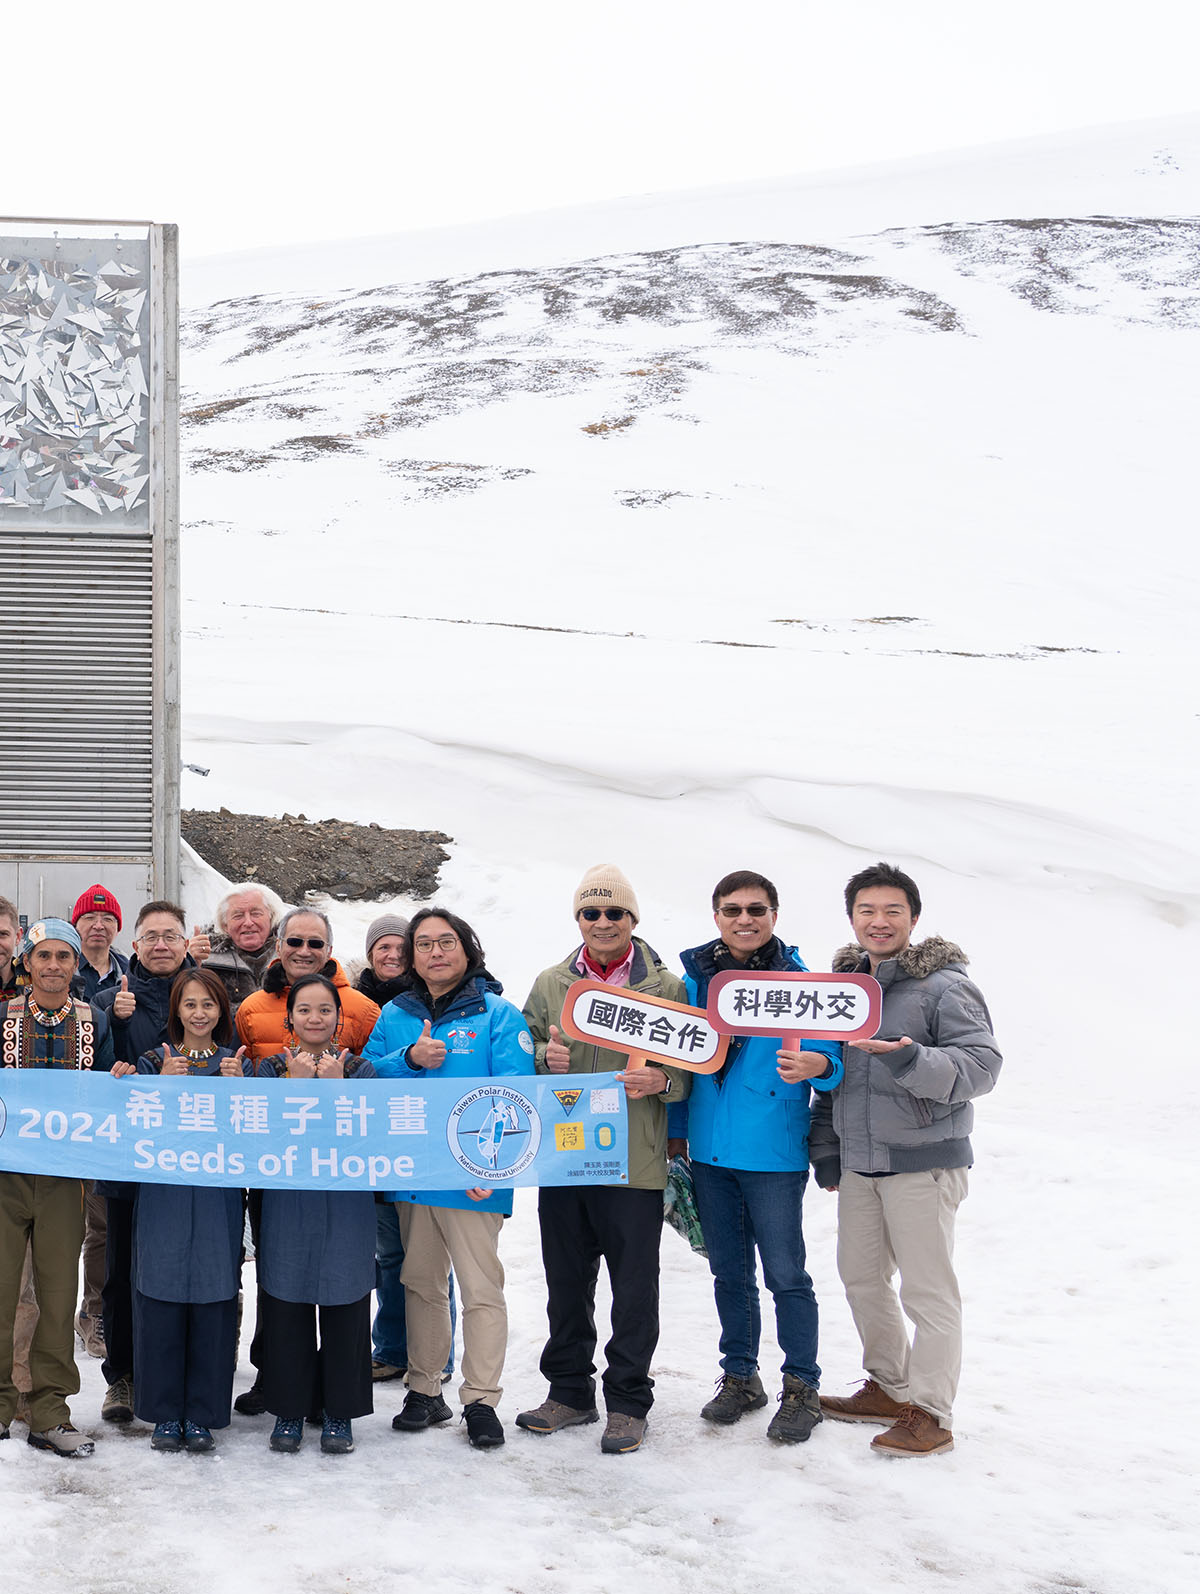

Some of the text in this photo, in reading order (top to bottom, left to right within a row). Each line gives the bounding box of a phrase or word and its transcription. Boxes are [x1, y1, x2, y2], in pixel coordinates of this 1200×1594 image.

[580, 888, 612, 900] COLORADO
[733, 988, 856, 1020] 科學外交
[586, 998, 708, 1052] 國際合作
[18, 1089, 429, 1144] 2024 希望種子計畫
[452, 1087, 533, 1118] Taiwan Polar Institute
[134, 1139, 415, 1187] Seeds of Hope
[458, 1151, 535, 1179] National Central University
